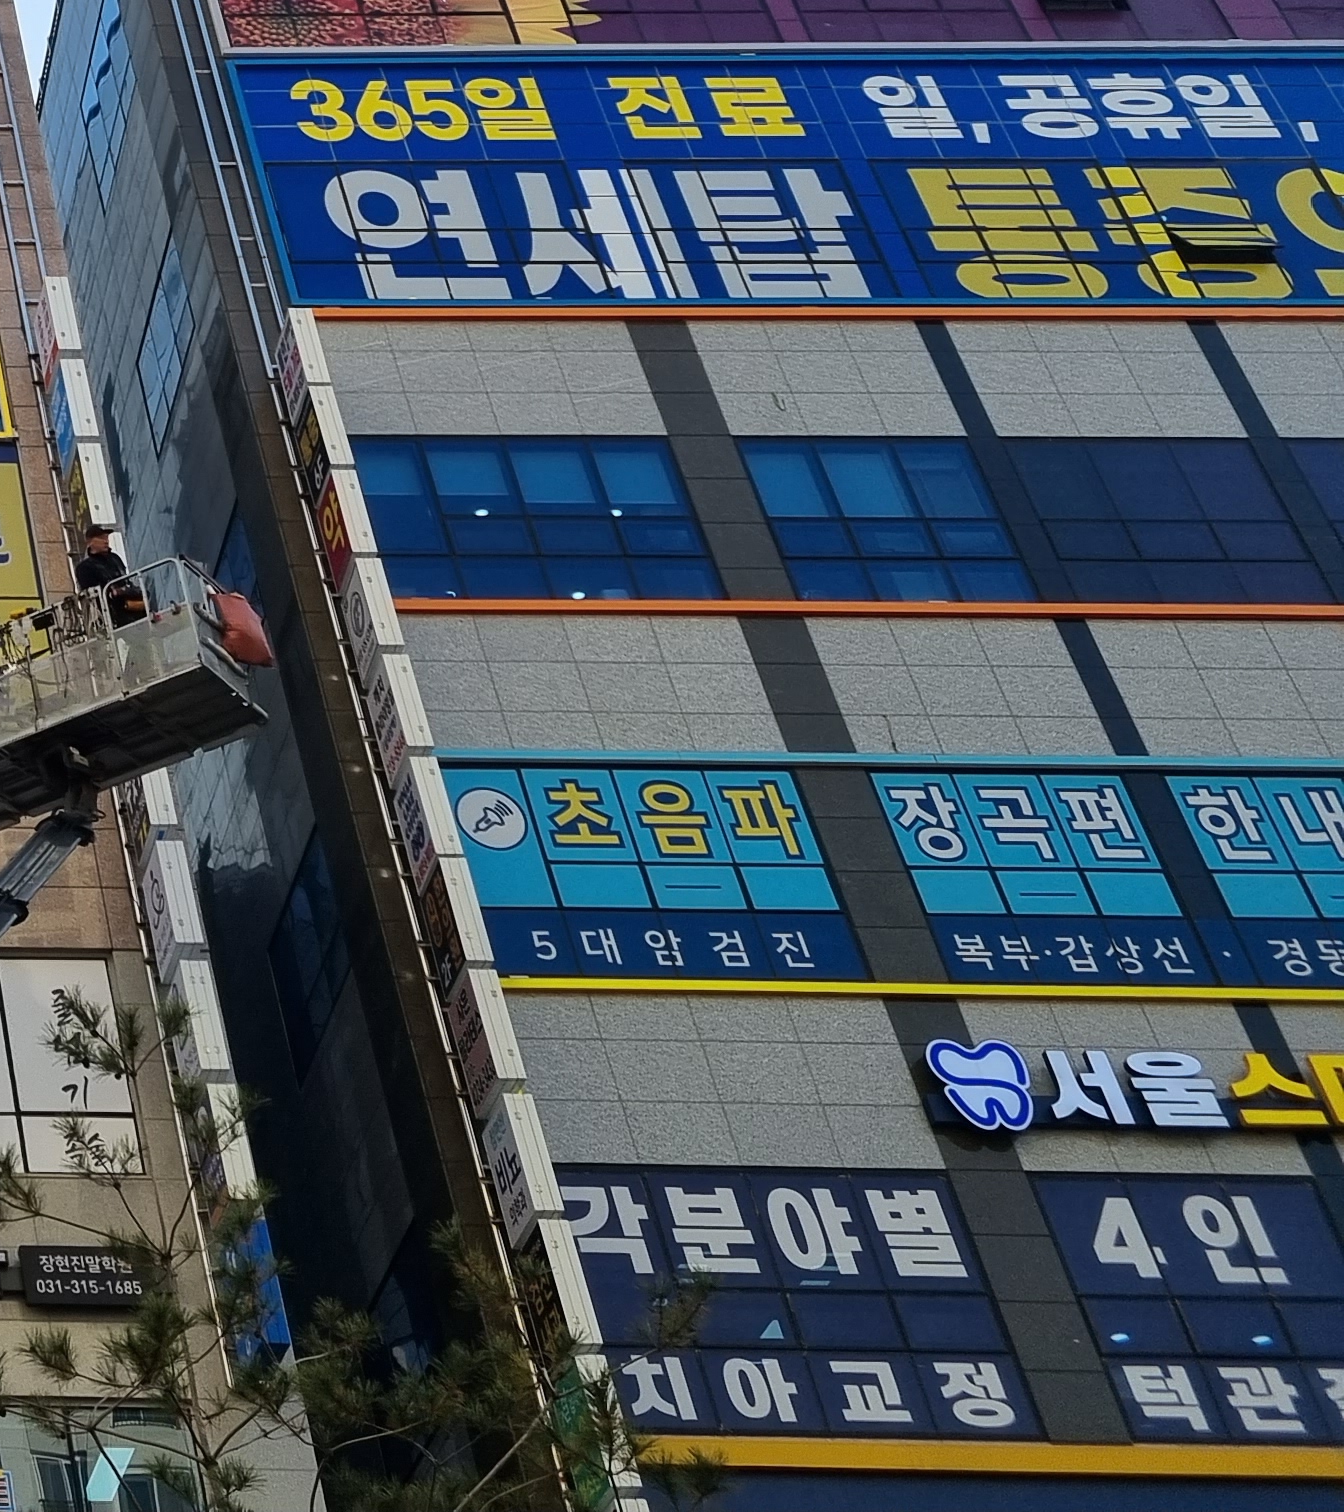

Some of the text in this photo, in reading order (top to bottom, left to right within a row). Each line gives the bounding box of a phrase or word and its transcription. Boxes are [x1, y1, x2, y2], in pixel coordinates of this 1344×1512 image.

[289, 72, 1321, 145] 365일 진료 일, 공휴일,
[324, 168, 873, 301] 연세탑
[546, 779, 801, 859] 초음파
[890, 782, 1150, 866] 장곡편
[562, 1184, 969, 1280] 각분야별
[1092, 1194, 1291, 1287] 4인
[35, 1278, 144, 1297] 031-315-1685
[622, 1353, 1017, 1430] 치아교정
